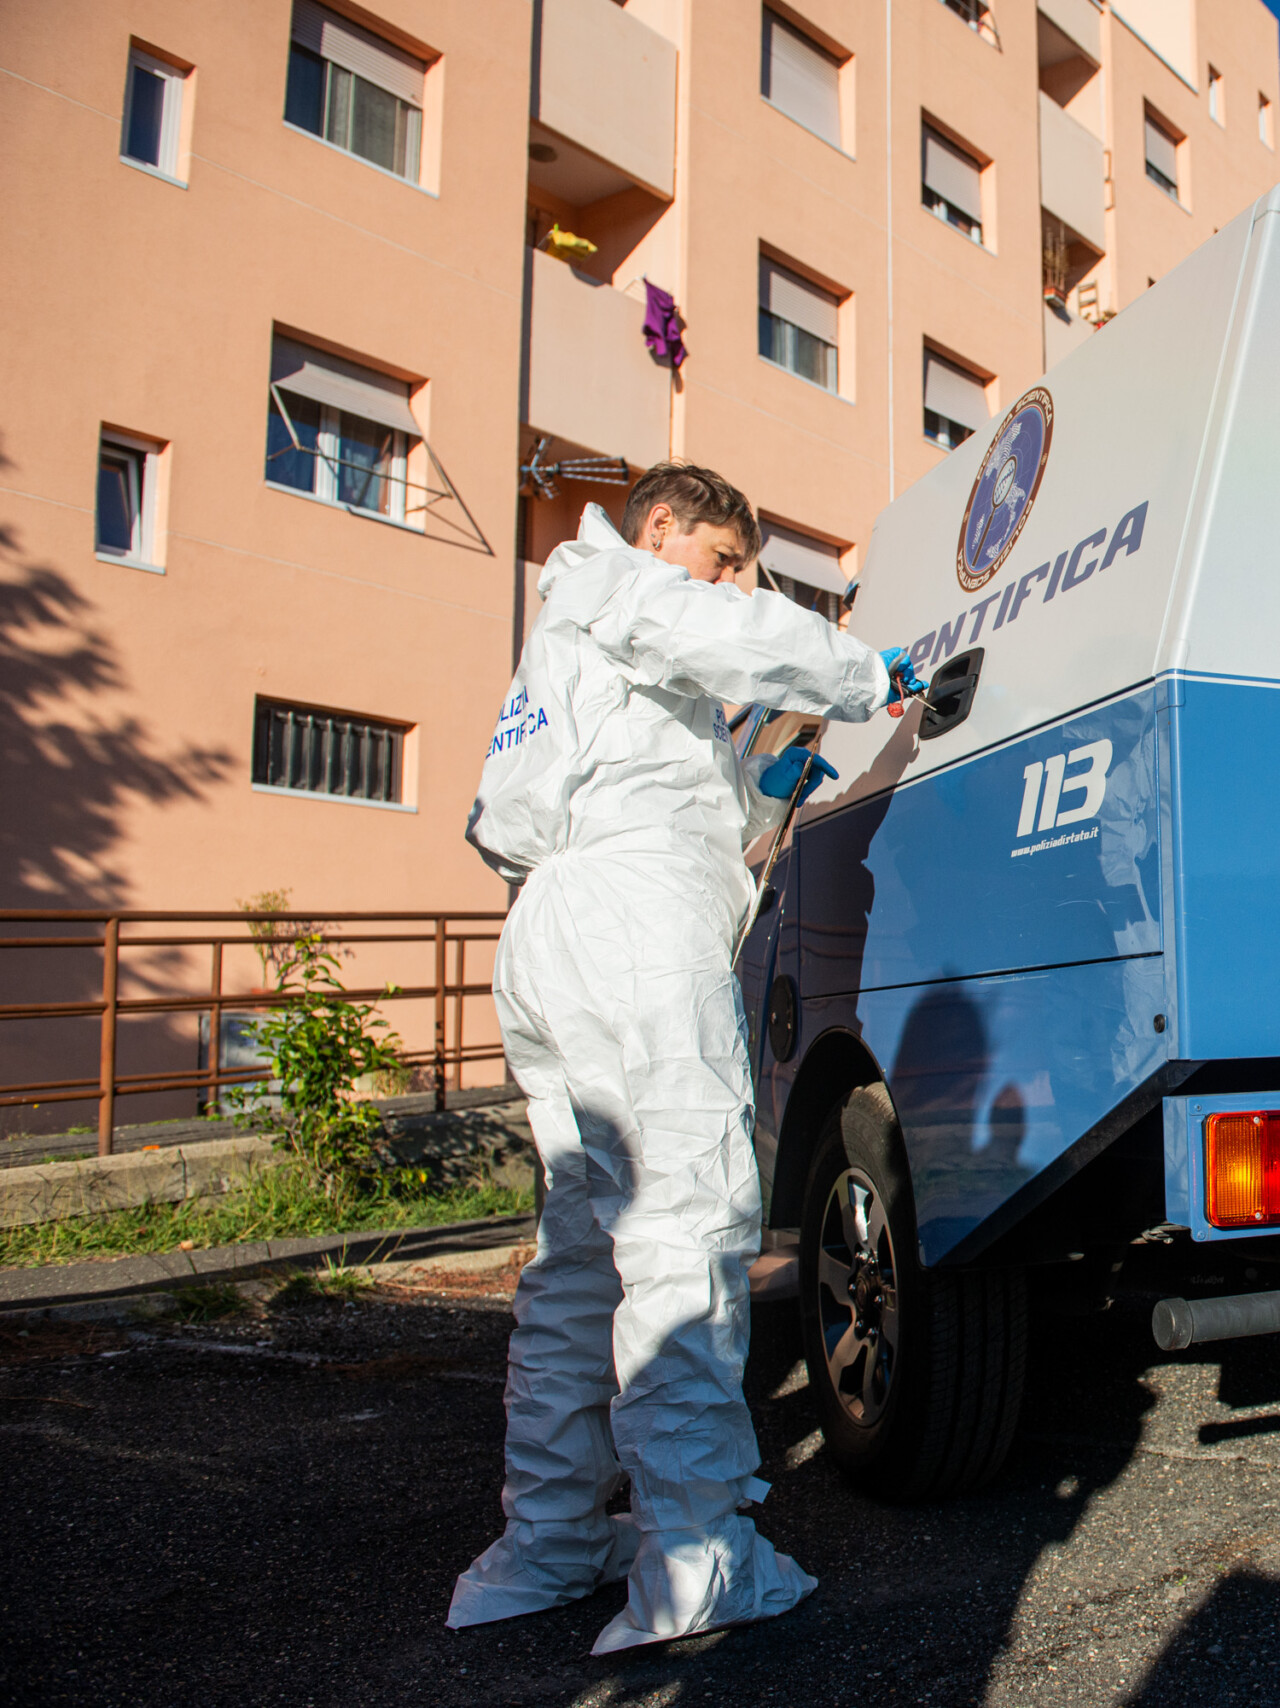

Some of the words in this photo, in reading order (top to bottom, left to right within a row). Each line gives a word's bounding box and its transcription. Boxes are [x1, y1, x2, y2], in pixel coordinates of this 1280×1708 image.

[904, 500, 1149, 675] ENTIFICA
[1016, 738, 1114, 838] 113
[1011, 826, 1099, 858] www.poliziadistato.it
